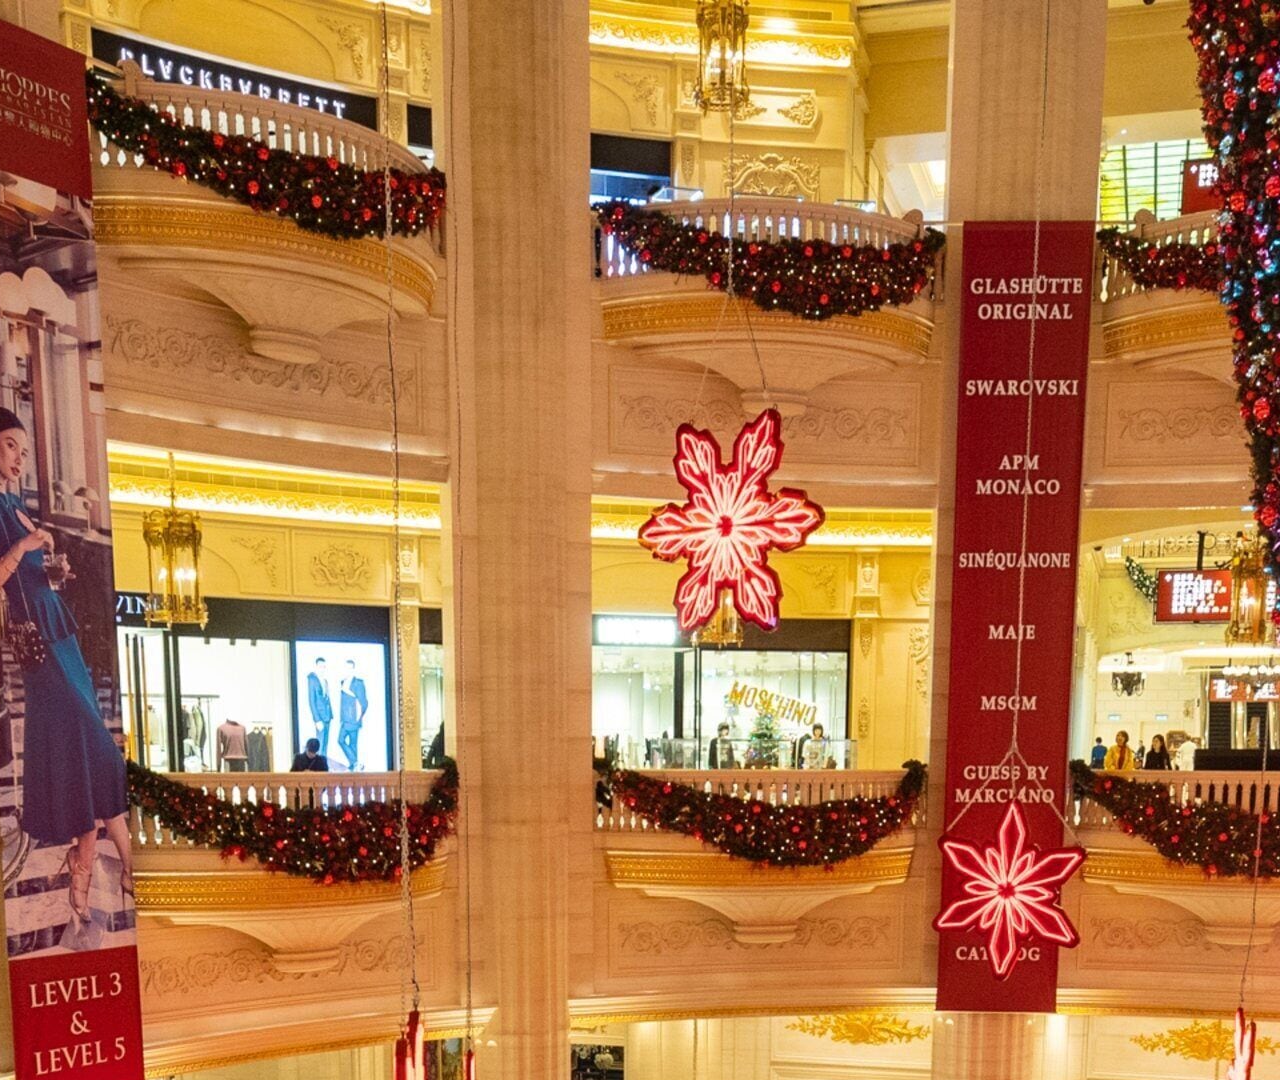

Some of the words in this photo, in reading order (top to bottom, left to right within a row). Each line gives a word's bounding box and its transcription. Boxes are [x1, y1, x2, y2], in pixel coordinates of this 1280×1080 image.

[970, 274, 1084, 295] GLASHÜTTE
[977, 303, 1073, 320] ORIGINAL
[965, 379, 1079, 396] SWAROVSKI
[998, 454, 1040, 471] APM
[975, 479, 1061, 496] MONACO
[958, 548, 1071, 571] SINÉQUANONE
[988, 624, 1036, 642] MAJE
[979, 696, 1038, 711] MSGM
[963, 765, 1021, 781] GUESS
[1026, 766, 1050, 780] BY
[955, 946, 1041, 962] CATOG
[29, 974, 104, 1008] LEVEL
[109, 971, 123, 997] 3
[70, 1010, 91, 1036] &
[34, 1040, 108, 1076] LEVEL
[114, 1036, 126, 1061] 5
